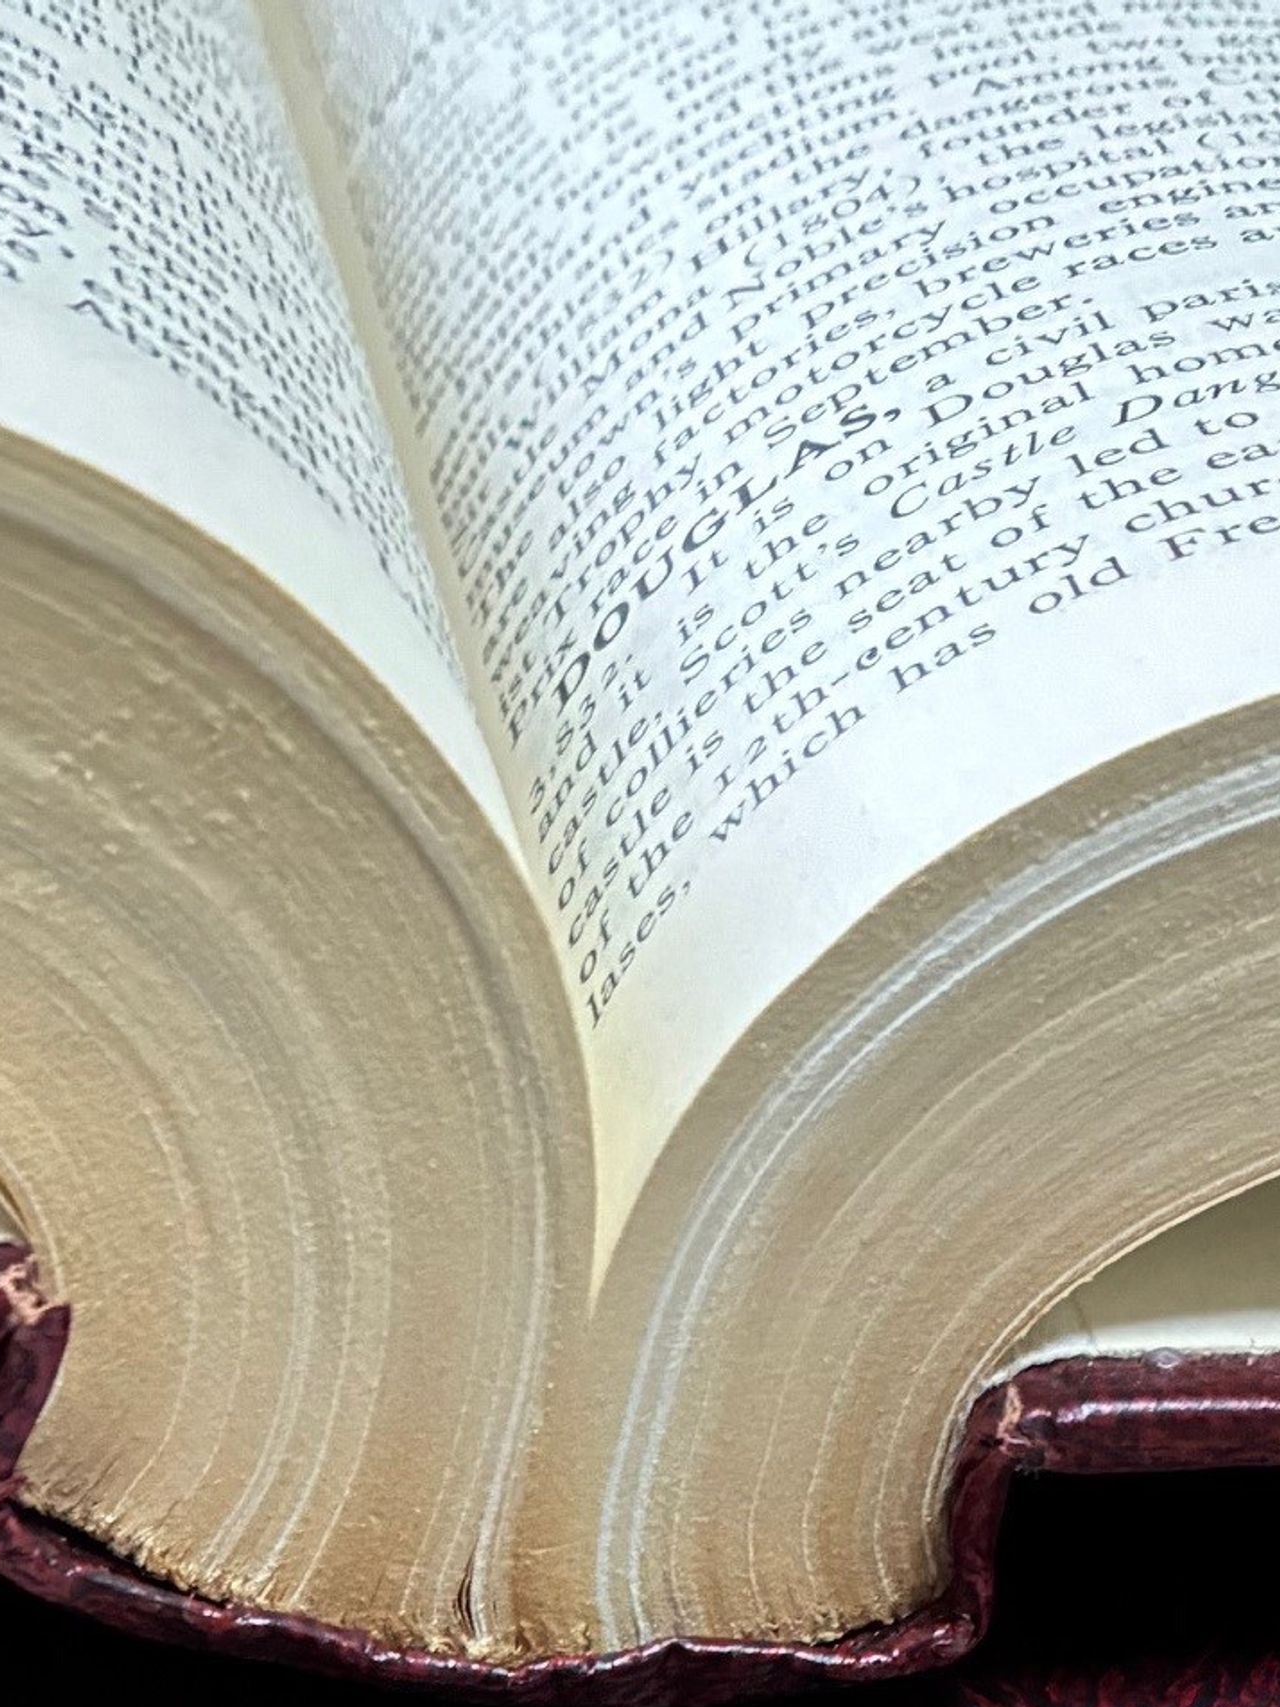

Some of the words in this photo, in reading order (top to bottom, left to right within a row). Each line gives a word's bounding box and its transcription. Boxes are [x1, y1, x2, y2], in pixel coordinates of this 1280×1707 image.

[730, 219, 948, 345] primary
[943, 133, 1171, 203] hospital
[977, 136, 1064, 167] the
[542, 451, 702, 629] Trophy
[724, 275, 1041, 446] motorcycle
[1062, 234, 1218, 280] races
[589, 513, 679, 621] race
[695, 458, 745, 507] in
[763, 293, 1094, 451] September.
[653, 307, 896, 470] factories,
[917, 210, 1201, 299] breweries
[655, 338, 770, 433] light
[801, 213, 1057, 331] precision
[680, 547, 730, 598] It
[751, 495, 795, 537] is
[823, 435, 893, 483] on
[920, 328, 1176, 429] Douglas
[538, 730, 598, 844] and
[619, 667, 651, 713] it
[675, 602, 717, 647] is
[743, 511, 830, 581] the
[862, 380, 1095, 497] original
[552, 402, 902, 717] DOUGLAS,
[925, 372, 956, 394] a
[984, 310, 1116, 366] civil
[888, 424, 1078, 520] Castle
[558, 838, 591, 911] of
[605, 607, 813, 828] collieries
[833, 475, 1042, 600] nearby
[1065, 427, 1171, 478] led
[1193, 410, 1260, 438] to
[568, 785, 672, 947] castle
[686, 729, 725, 778] is
[741, 640, 829, 715] the
[846, 551, 968, 635] seat
[990, 503, 1053, 550] of
[1078, 465, 1184, 512] the
[579, 908, 612, 985] of
[627, 810, 693, 900] the
[714, 532, 1090, 795] 12th-century
[708, 702, 867, 843] which
[887, 621, 997, 694] has
[1027, 556, 1132, 615] old
